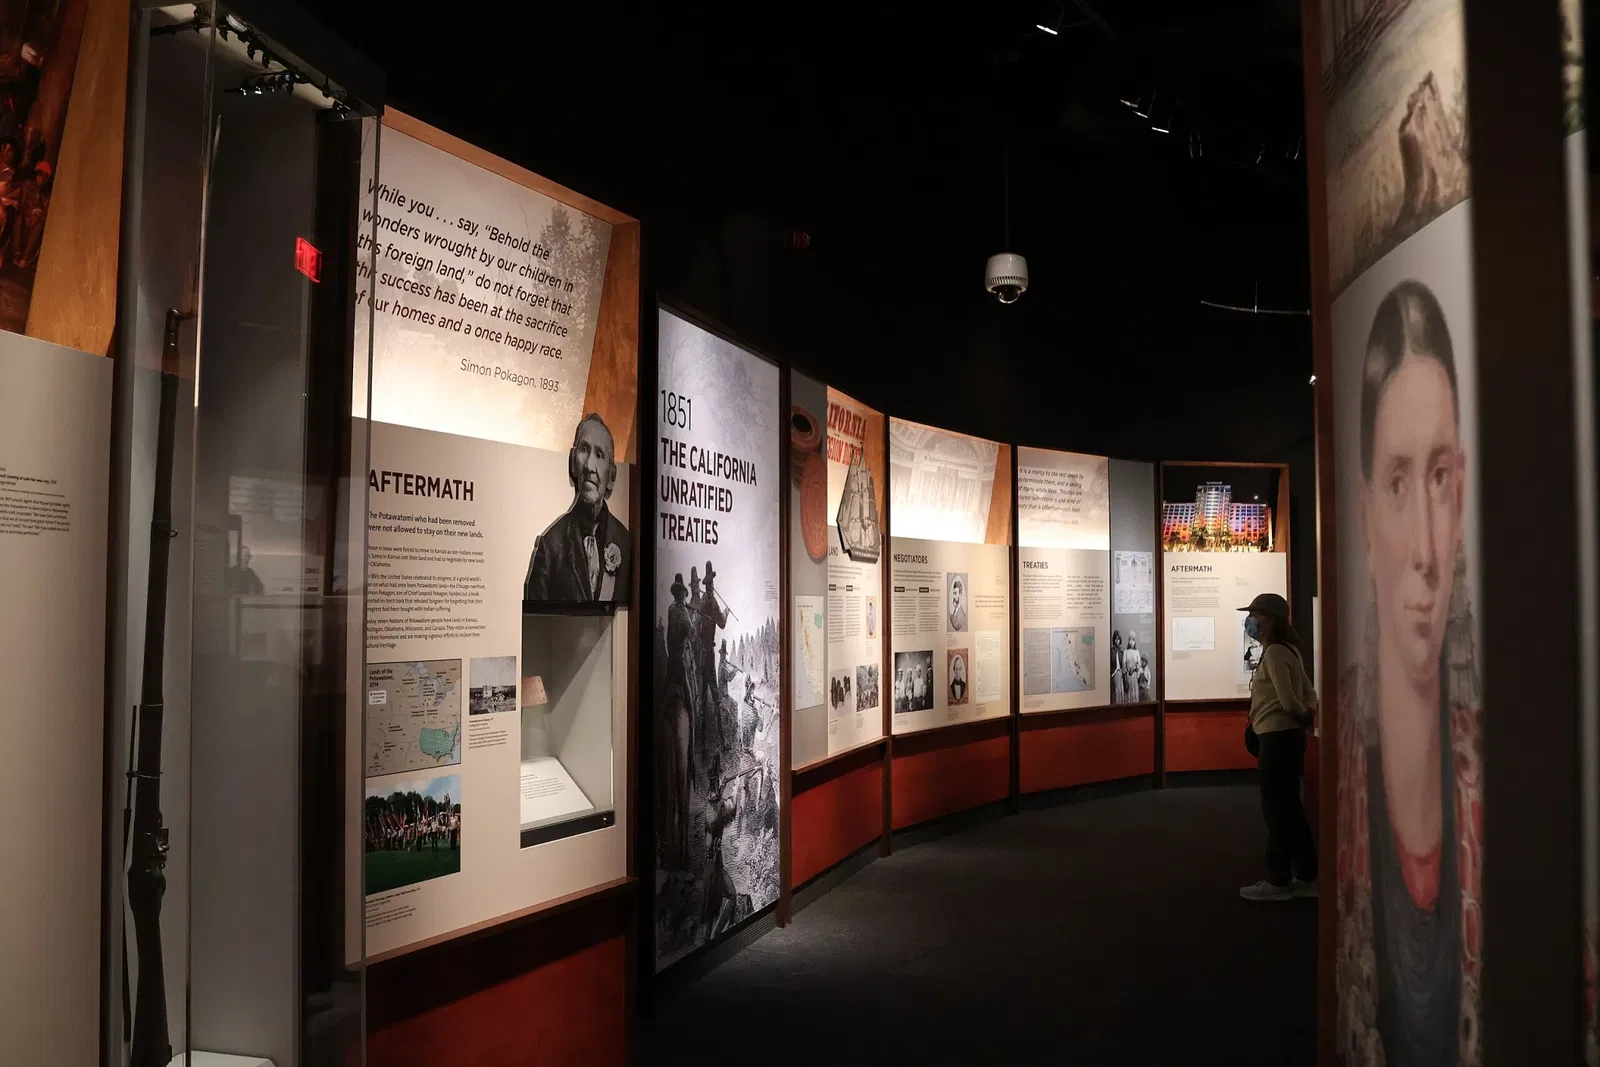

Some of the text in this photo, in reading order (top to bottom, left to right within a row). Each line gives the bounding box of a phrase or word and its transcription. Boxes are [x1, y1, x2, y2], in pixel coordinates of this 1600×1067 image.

[367, 179, 405, 207] While
[408, 197, 435, 218] you
[457, 217, 479, 238] say,
[532, 241, 549, 261] the
[362, 208, 574, 293] wonders wrought by our children in
[357, 234, 382, 255] ths
[385, 243, 433, 272] foreign
[476, 272, 491, 290] do
[493, 282, 514, 297] not
[515, 286, 549, 310] forget
[551, 299, 572, 315] that
[380, 272, 431, 298] success
[434, 285, 455, 304] has
[458, 292, 488, 314] been
[490, 306, 503, 319] at
[505, 307, 523, 324] the
[525, 316, 568, 338] sacrifice
[392, 303, 435, 325] homes
[438, 314, 464, 334] and
[464, 323, 471, 334] a
[475, 326, 502, 343] once
[504, 332, 537, 355] happy
[539, 345, 563, 360] race.
[460, 358, 559, 393] Simon Pokagon, 1893
[661, 390, 692, 430] 1851
[661, 437, 757, 486] THE CALIFORNIA
[369, 469, 474, 501] AFTERMATH
[661, 475, 733, 512] UNRATIFIED
[379, 512, 413, 521] Potawatomi
[415, 515, 426, 523] who
[428, 516, 438, 524] had
[439, 517, 452, 525] been
[393, 525, 416, 533] allowed
[424, 528, 435, 537] stay
[469, 530, 483, 538] lands.
[660, 512, 718, 545] TREATIES
[829, 546, 838, 556] LAND
[894, 553, 928, 564] NEGOTIATORS
[1023, 561, 1048, 569] TREATIES
